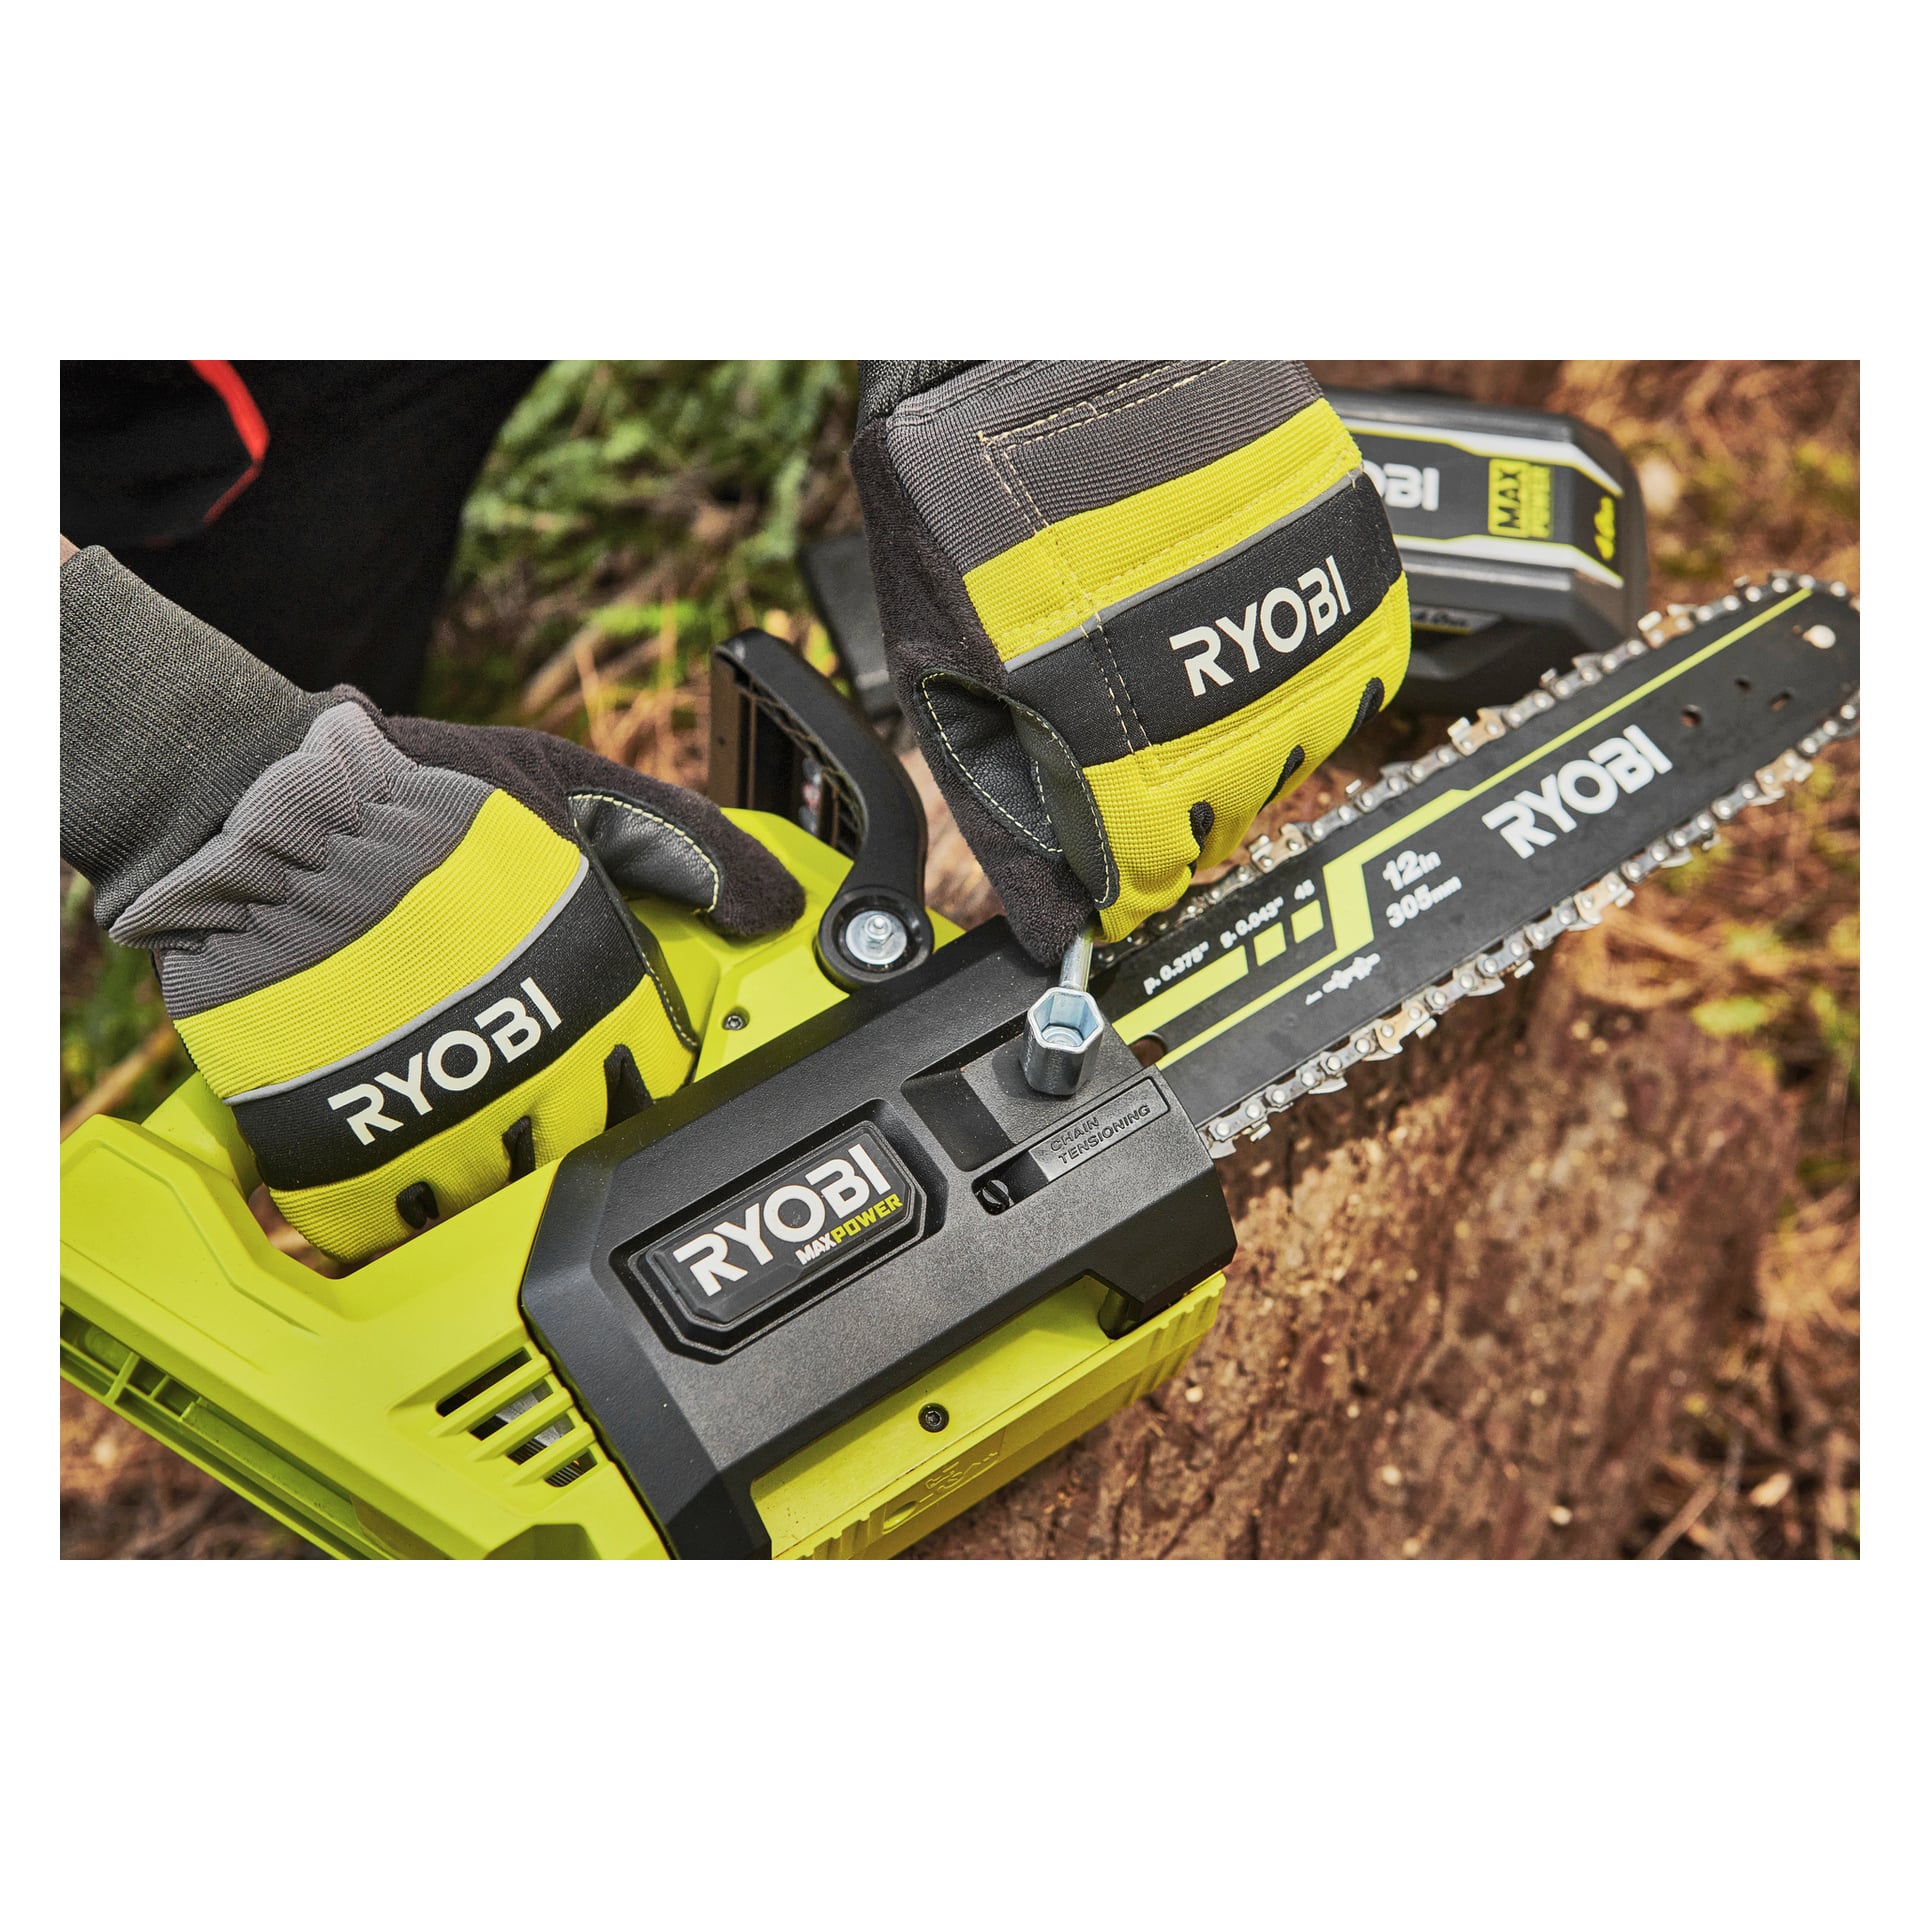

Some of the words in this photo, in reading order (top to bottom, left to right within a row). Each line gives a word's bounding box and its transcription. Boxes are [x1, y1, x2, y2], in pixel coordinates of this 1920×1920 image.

[1497, 471, 1522, 531] MAX
[1169, 555, 1351, 697] RYOBI
[1481, 723, 1673, 860] RYOBI
[1294, 879, 1315, 901] 45
[1382, 850, 1441, 891] 12in
[1385, 876, 1462, 928] 305mm
[327, 976, 562, 1146] RYOBI
[1051, 1116, 1100, 1152] CHAIN
[1058, 1104, 1151, 1164] TENSIONING
[672, 1143, 891, 1297] RYOBI
